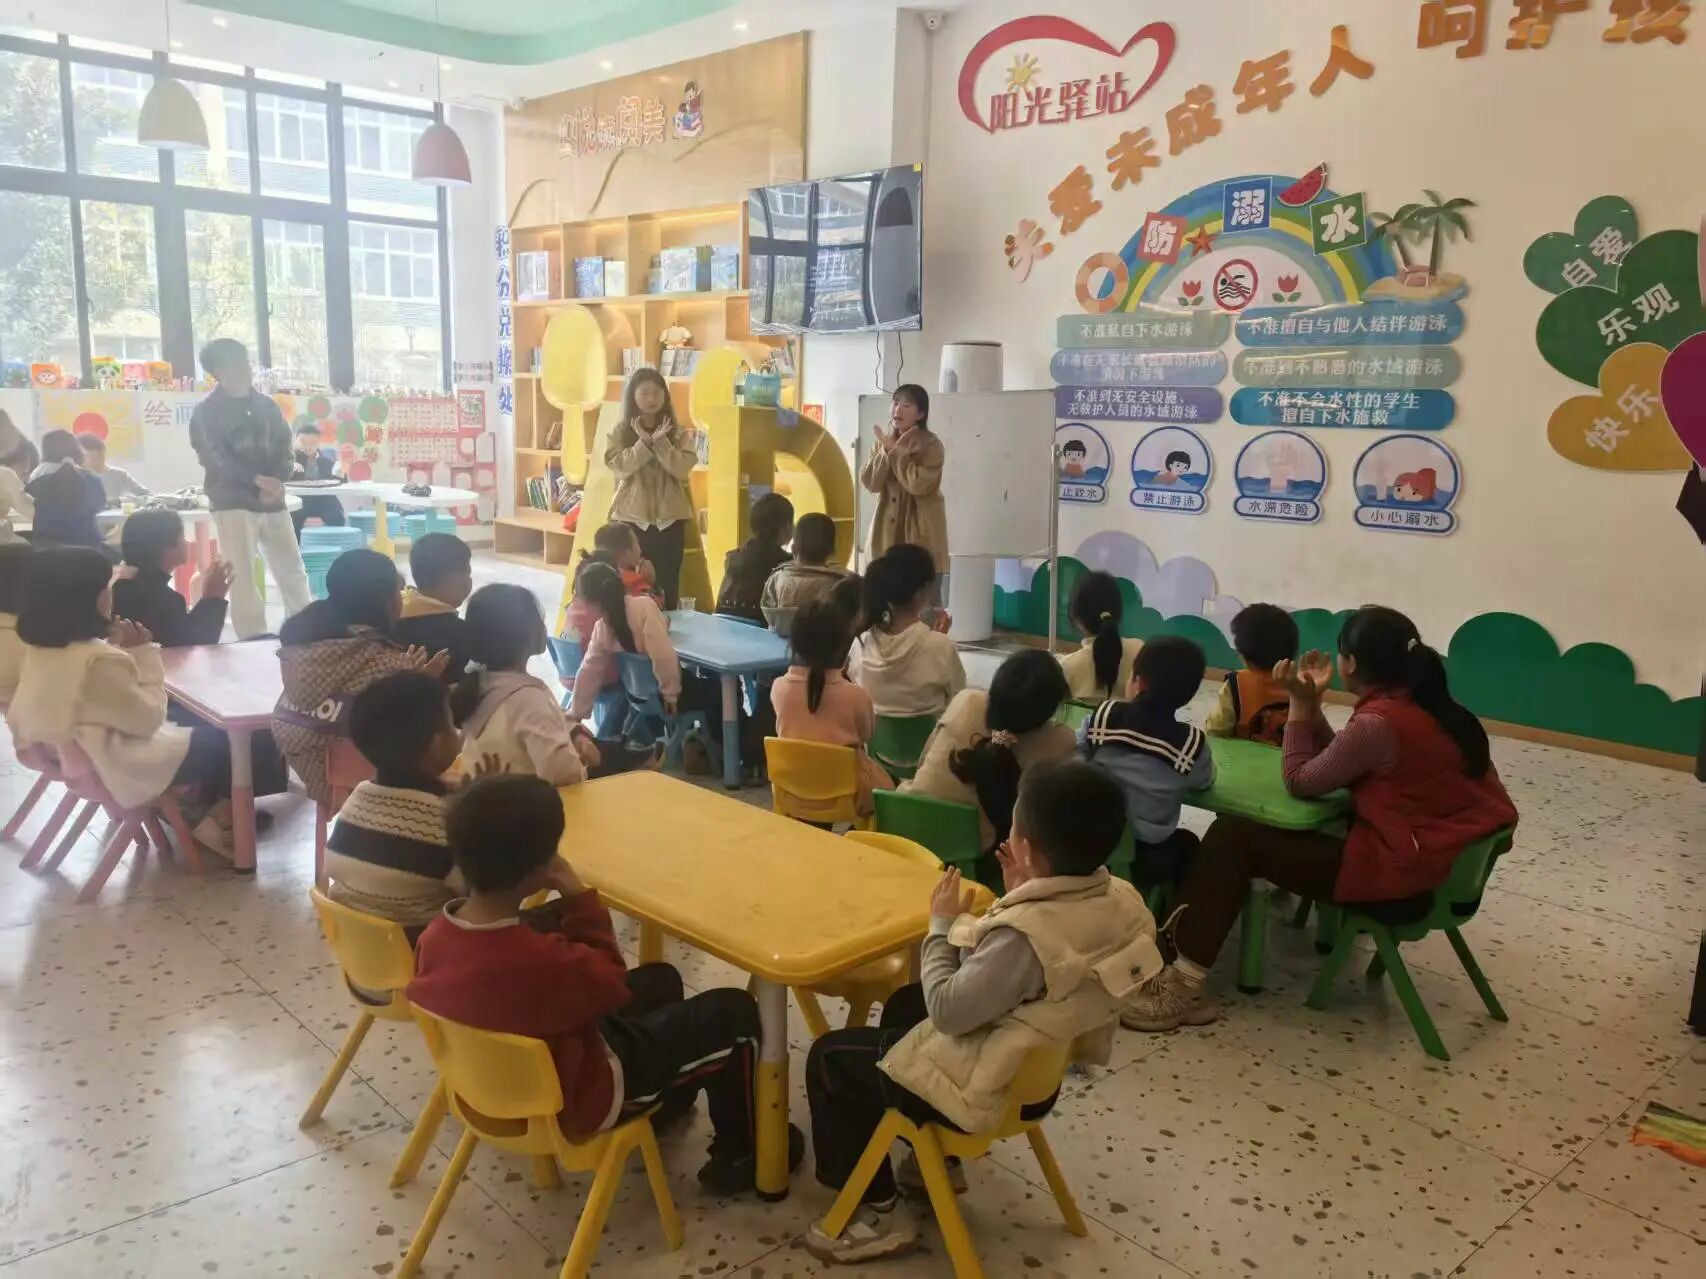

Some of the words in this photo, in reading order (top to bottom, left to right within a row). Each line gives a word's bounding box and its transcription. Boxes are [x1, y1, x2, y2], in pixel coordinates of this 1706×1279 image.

[989, 71, 1130, 131] 阳光驿站
[1144, 187, 1360, 255] 防溺水
[1561, 226, 1633, 288] 自爱
[496, 227, 512, 414] 积分兑换处
[1597, 282, 1680, 346] 乐观
[1080, 322, 1193, 338] 不准私自下水游泳
[1248, 314, 1447, 336] 不准擅自与他人结伴游泳
[1244, 358, 1443, 377] 不准到不熟悉的水域游泳
[1258, 391, 1421, 409] 不准不会水性的学生
[1067, 403, 1198, 419] 无救护人员的水域游泳
[1282, 407, 1389, 425] 擅自下水施救
[1584, 384, 1661, 453] 快乐
[1142, 491, 1195, 507] 禁止游泳
[1248, 500, 1310, 518] 水深危险
[1370, 509, 1440, 528] 小心溺水
